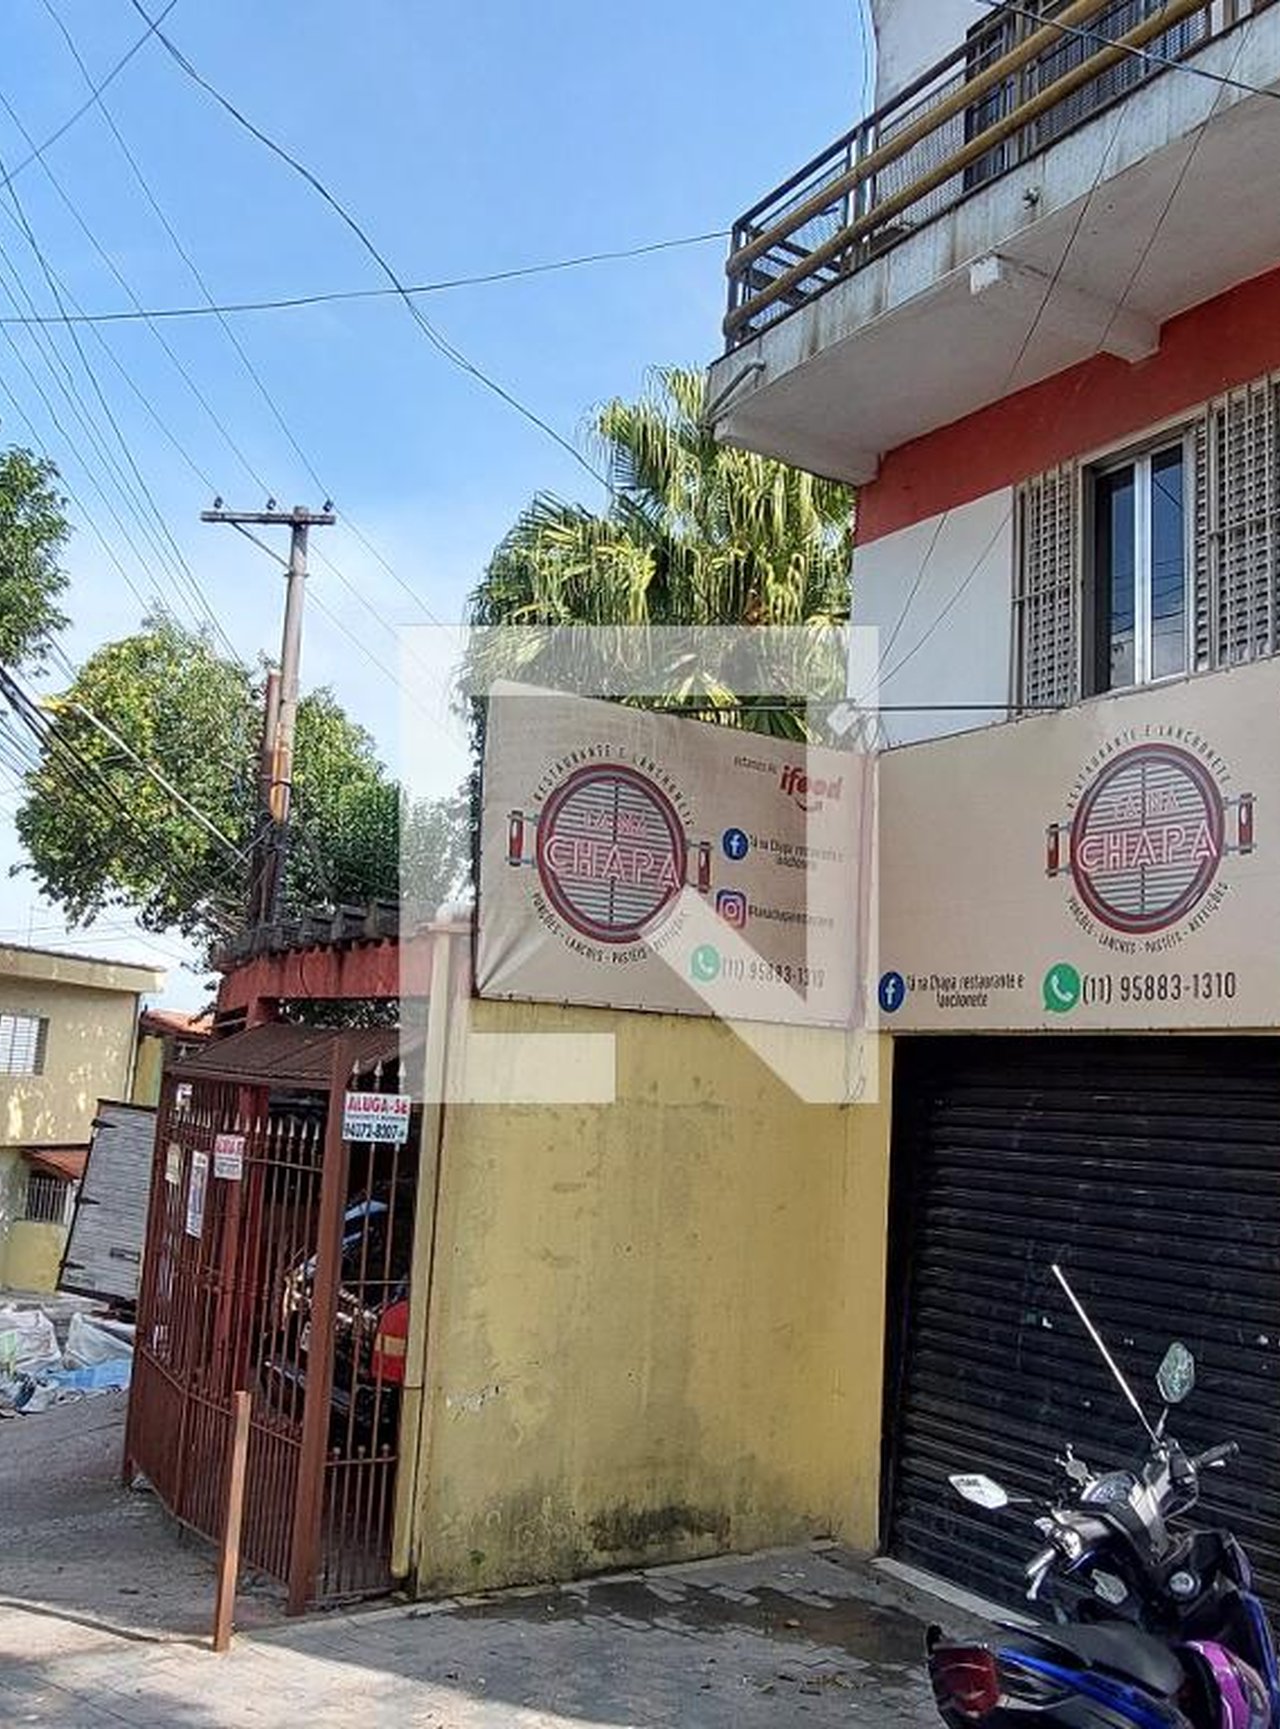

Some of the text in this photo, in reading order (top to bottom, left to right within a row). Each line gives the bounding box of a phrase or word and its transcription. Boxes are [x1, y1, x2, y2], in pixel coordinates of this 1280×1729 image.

[544, 835, 681, 891] CHAPA
[1076, 820, 1218, 873] CHAPA
[1082, 972, 1237, 1006] (11) 95883-1310
[346, 1096, 408, 1114] ALUGA-SE
